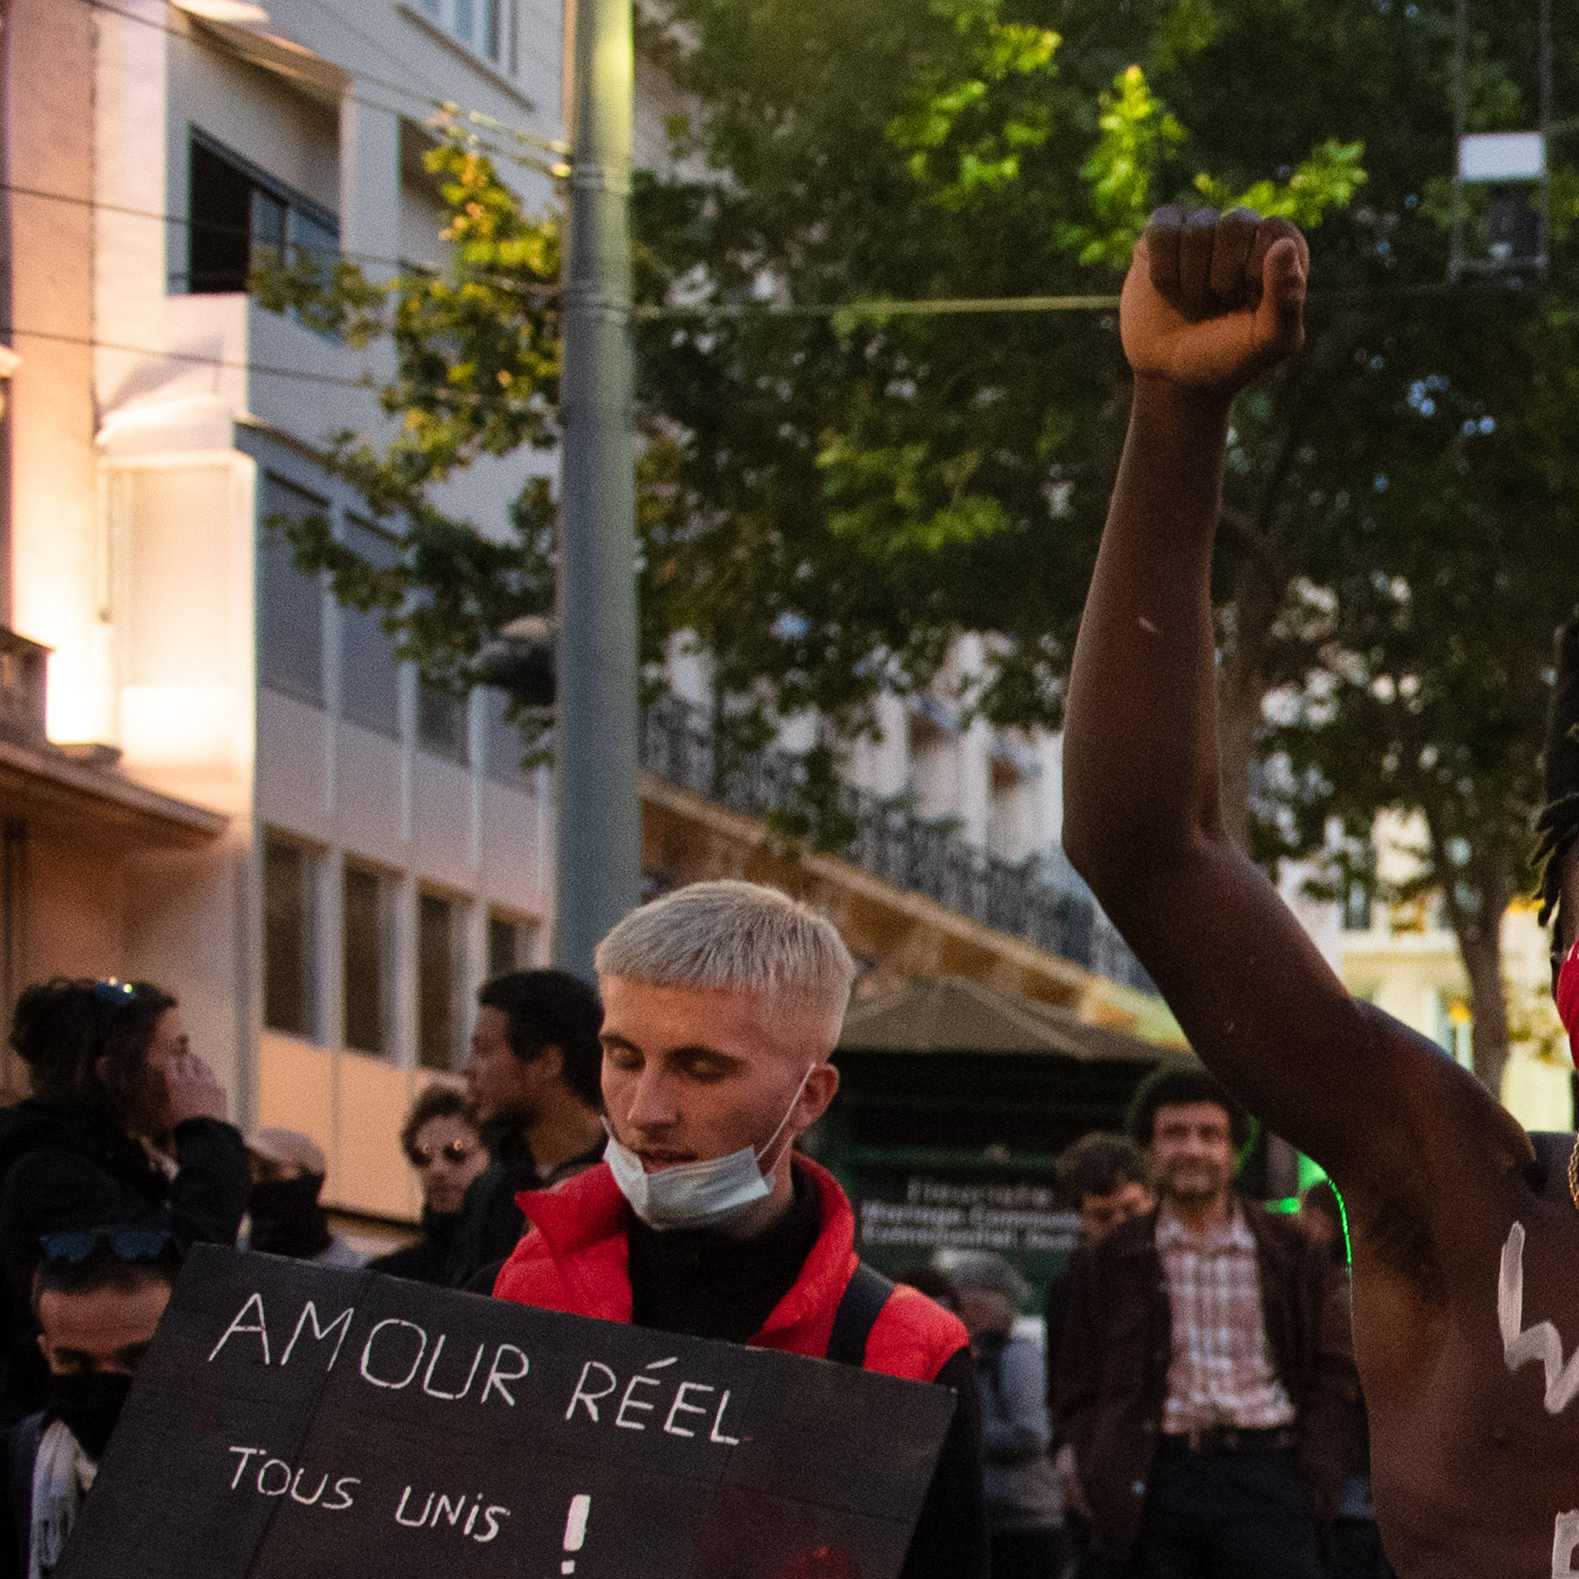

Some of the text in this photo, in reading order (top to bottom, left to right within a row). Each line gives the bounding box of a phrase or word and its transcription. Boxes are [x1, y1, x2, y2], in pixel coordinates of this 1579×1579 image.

[208, 1292, 740, 1446] AMOUR RÉEL
[228, 1446, 360, 1510] TOUS
